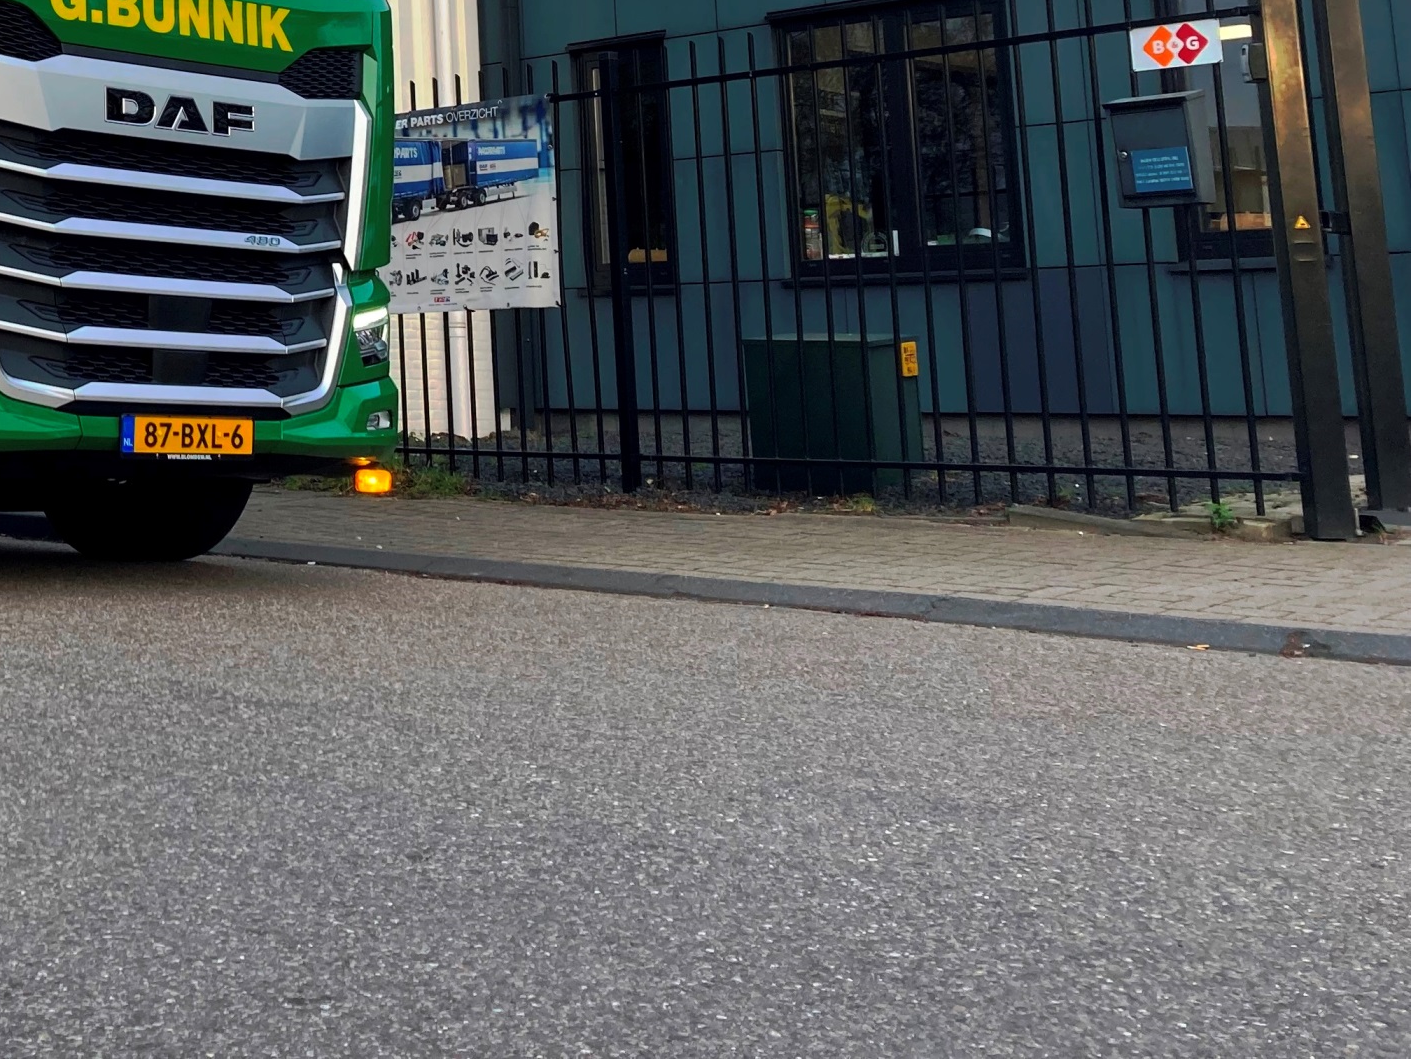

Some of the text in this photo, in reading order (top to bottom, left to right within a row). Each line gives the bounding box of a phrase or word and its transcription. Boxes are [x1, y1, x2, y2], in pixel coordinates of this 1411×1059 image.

[103, 85, 256, 137] DAF
[410, 113, 444, 128] PARTS
[445, 105, 499, 123] OVERZICHT
[123, 422, 244, 450] NL 87-BXL-6
